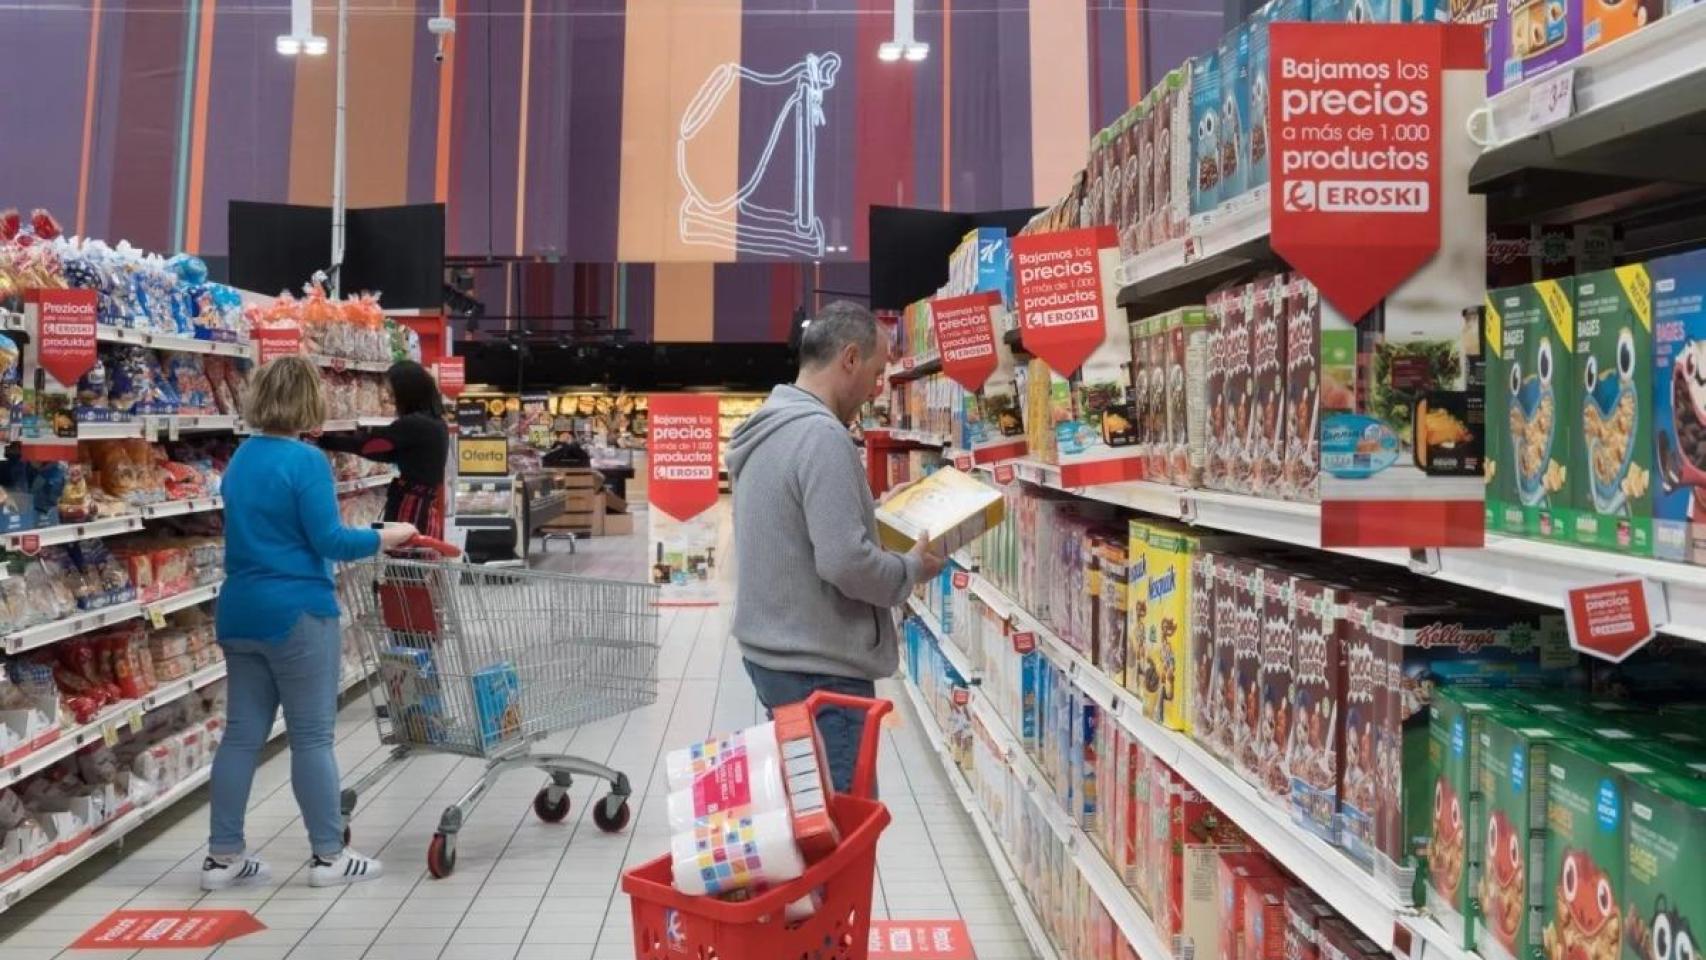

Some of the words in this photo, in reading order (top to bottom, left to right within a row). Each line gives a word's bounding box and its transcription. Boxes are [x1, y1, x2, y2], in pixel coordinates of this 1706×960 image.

[1281, 58, 1390, 80] Bajamos
[1397, 58, 1429, 79] los
[1281, 82, 1429, 121] precios
[1282, 127, 1297, 141] a
[1301, 123, 1343, 141] más
[1346, 123, 1374, 141] de
[1379, 124, 1430, 141] 1.000
[1282, 146, 1430, 174] productos
[1326, 186, 1422, 206] EROSKI
[1018, 250, 1073, 265] Bajamos
[1075, 247, 1092, 257] los
[1020, 259, 1093, 286] precios
[43, 302, 94, 314] Prezioak
[1024, 290, 1097, 311] productos
[939, 314, 987, 332] precios
[1047, 309, 1095, 324] EROSKI
[941, 333, 991, 350] productos
[653, 426, 713, 442] precios
[462, 449, 504, 462] Oferta
[653, 451, 713, 465] productos
[670, 468, 710, 477] EROSKI
[1415, 621, 1495, 653] Kellogg's
